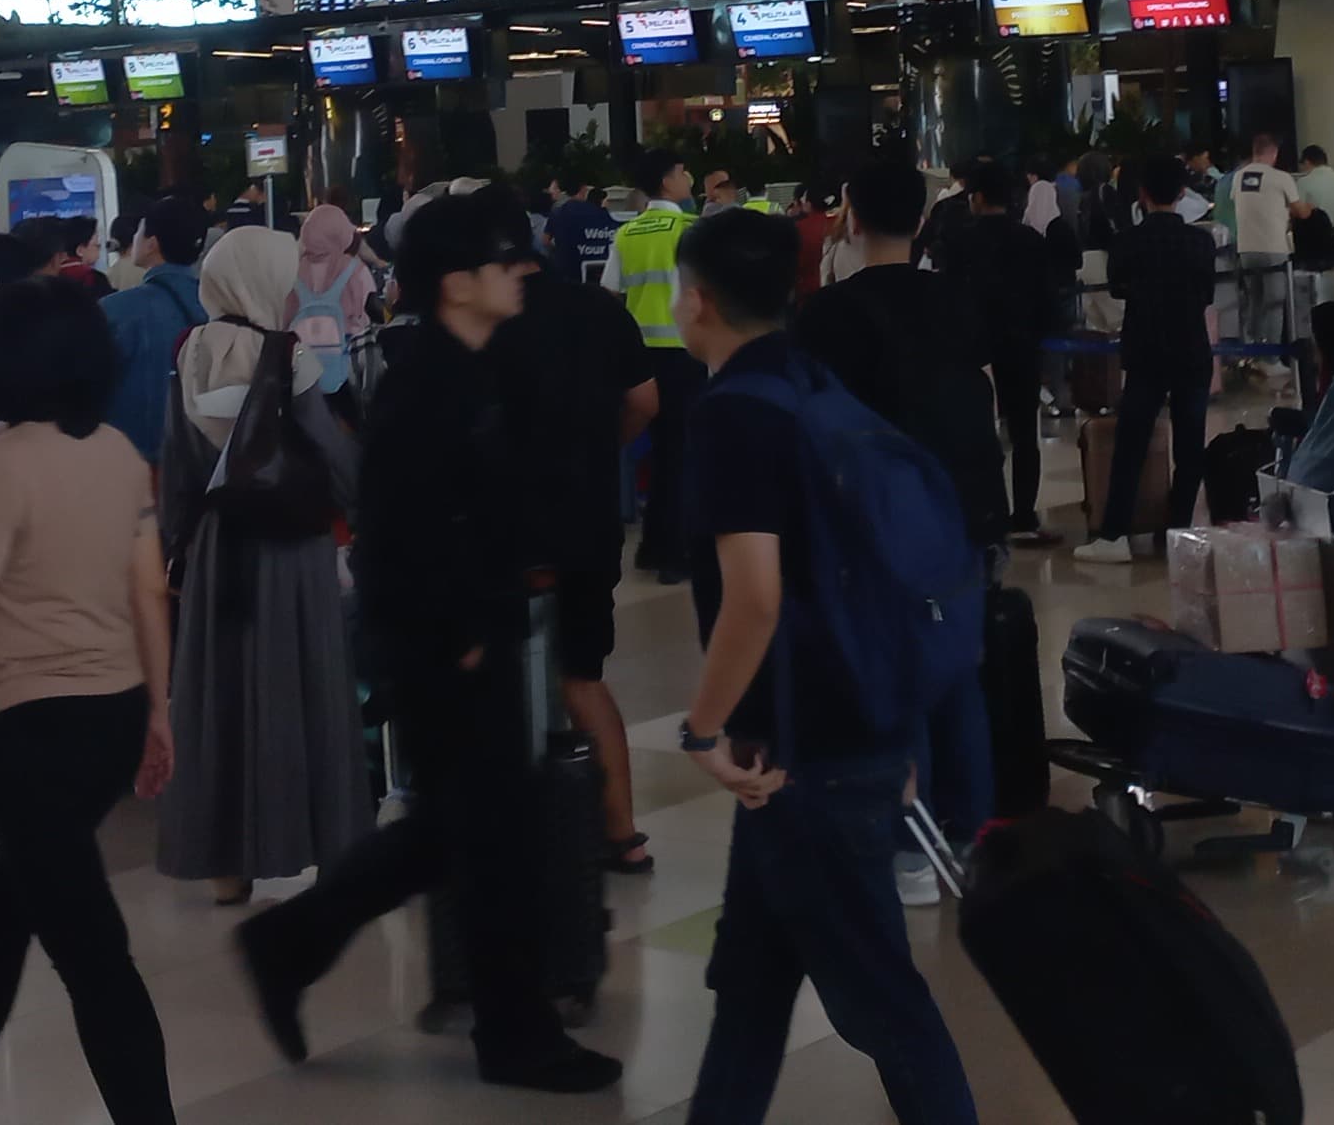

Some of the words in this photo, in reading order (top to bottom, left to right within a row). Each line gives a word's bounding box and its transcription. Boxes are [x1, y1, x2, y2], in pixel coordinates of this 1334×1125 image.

[737, 12, 746, 25] 4
[762, 11, 786, 19] PELITA
[625, 21, 634, 33] 5
[648, 19, 673, 27] PELITA
[408, 37, 415, 49] 6
[314, 46, 321, 58] 7
[584, 227, 616, 242] Weig
[577, 244, 606, 255] Your
